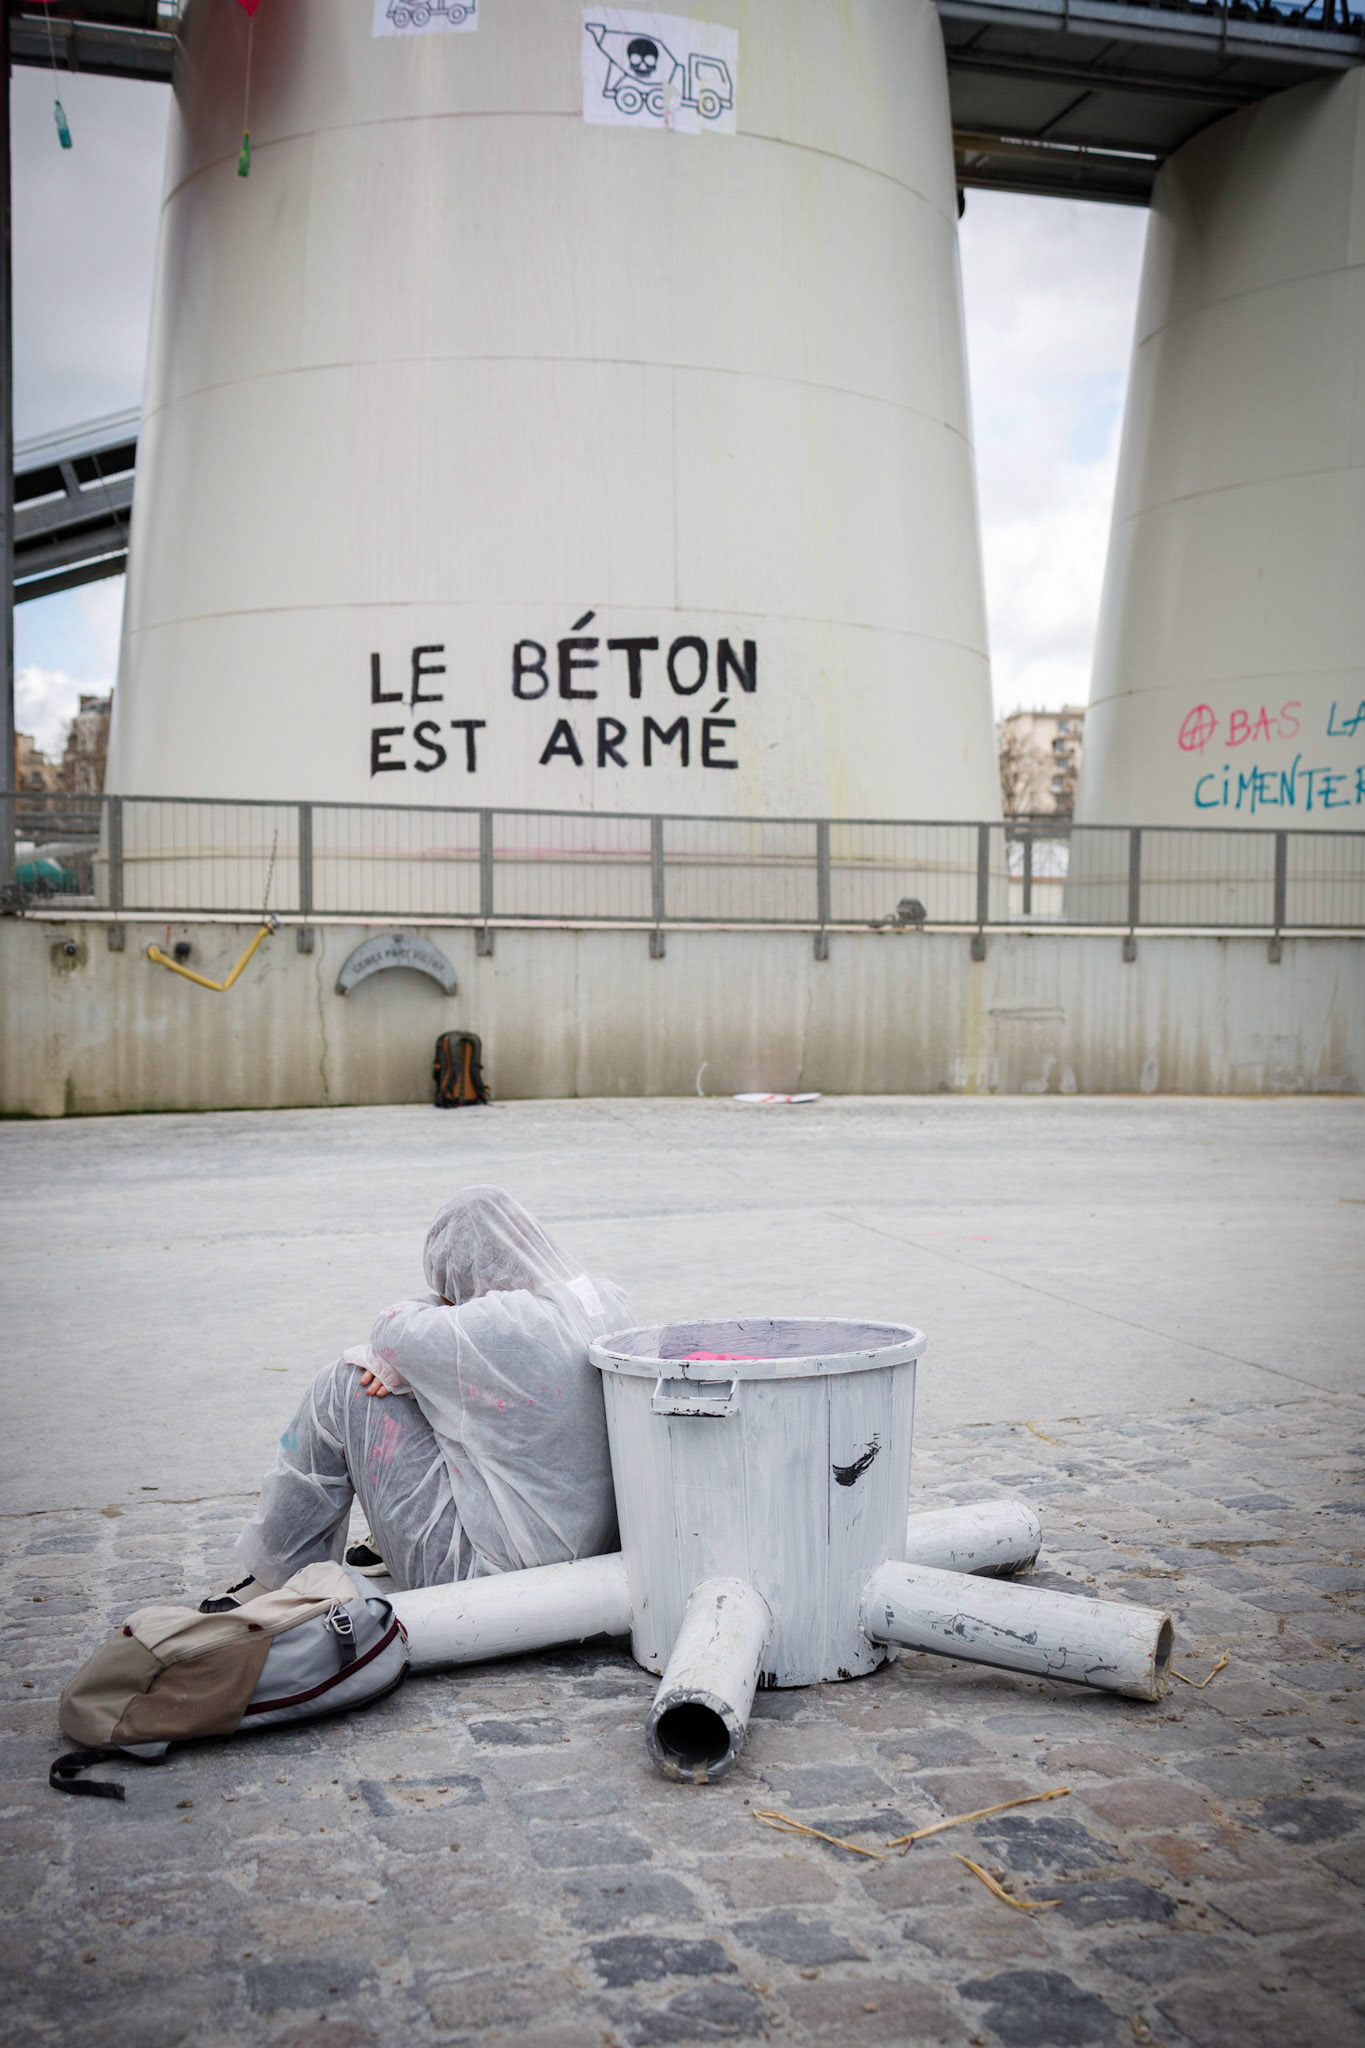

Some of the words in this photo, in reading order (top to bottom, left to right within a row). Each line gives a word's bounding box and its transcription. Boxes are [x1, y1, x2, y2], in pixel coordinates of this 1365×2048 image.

[371, 644, 447, 713] LE
[511, 610, 758, 700] BÉTON
[370, 719, 487, 778] EST
[538, 697, 740, 769] ARMÉ
[1225, 701, 1302, 747] BAS
